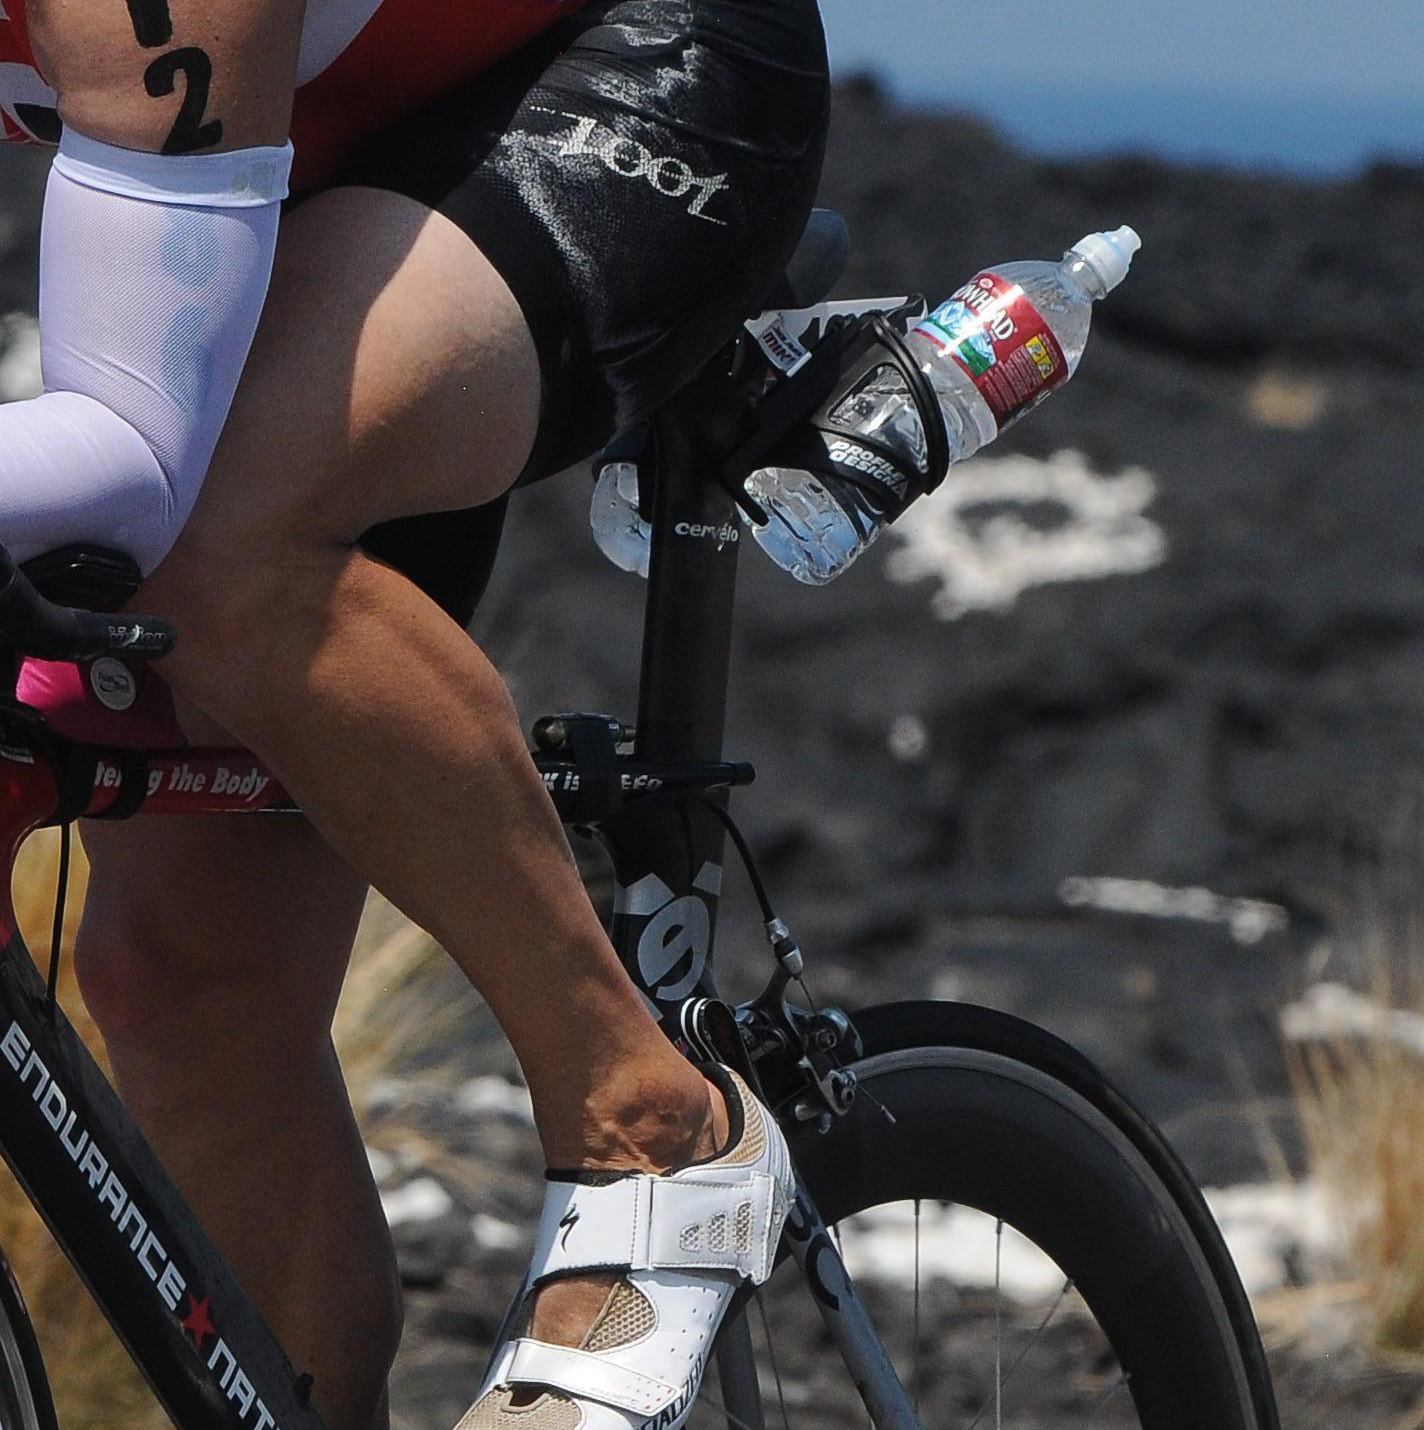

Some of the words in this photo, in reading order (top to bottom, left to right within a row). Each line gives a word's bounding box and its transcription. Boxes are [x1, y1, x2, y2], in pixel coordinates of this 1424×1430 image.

[829, 440, 904, 482] PROFILE
[830, 451, 894, 488] DESIGN
[675, 521, 739, 545] cervélo
[168, 762, 205, 793] the
[210, 766, 269, 802] Body
[0, 1020, 188, 1311] ENDURANCE
